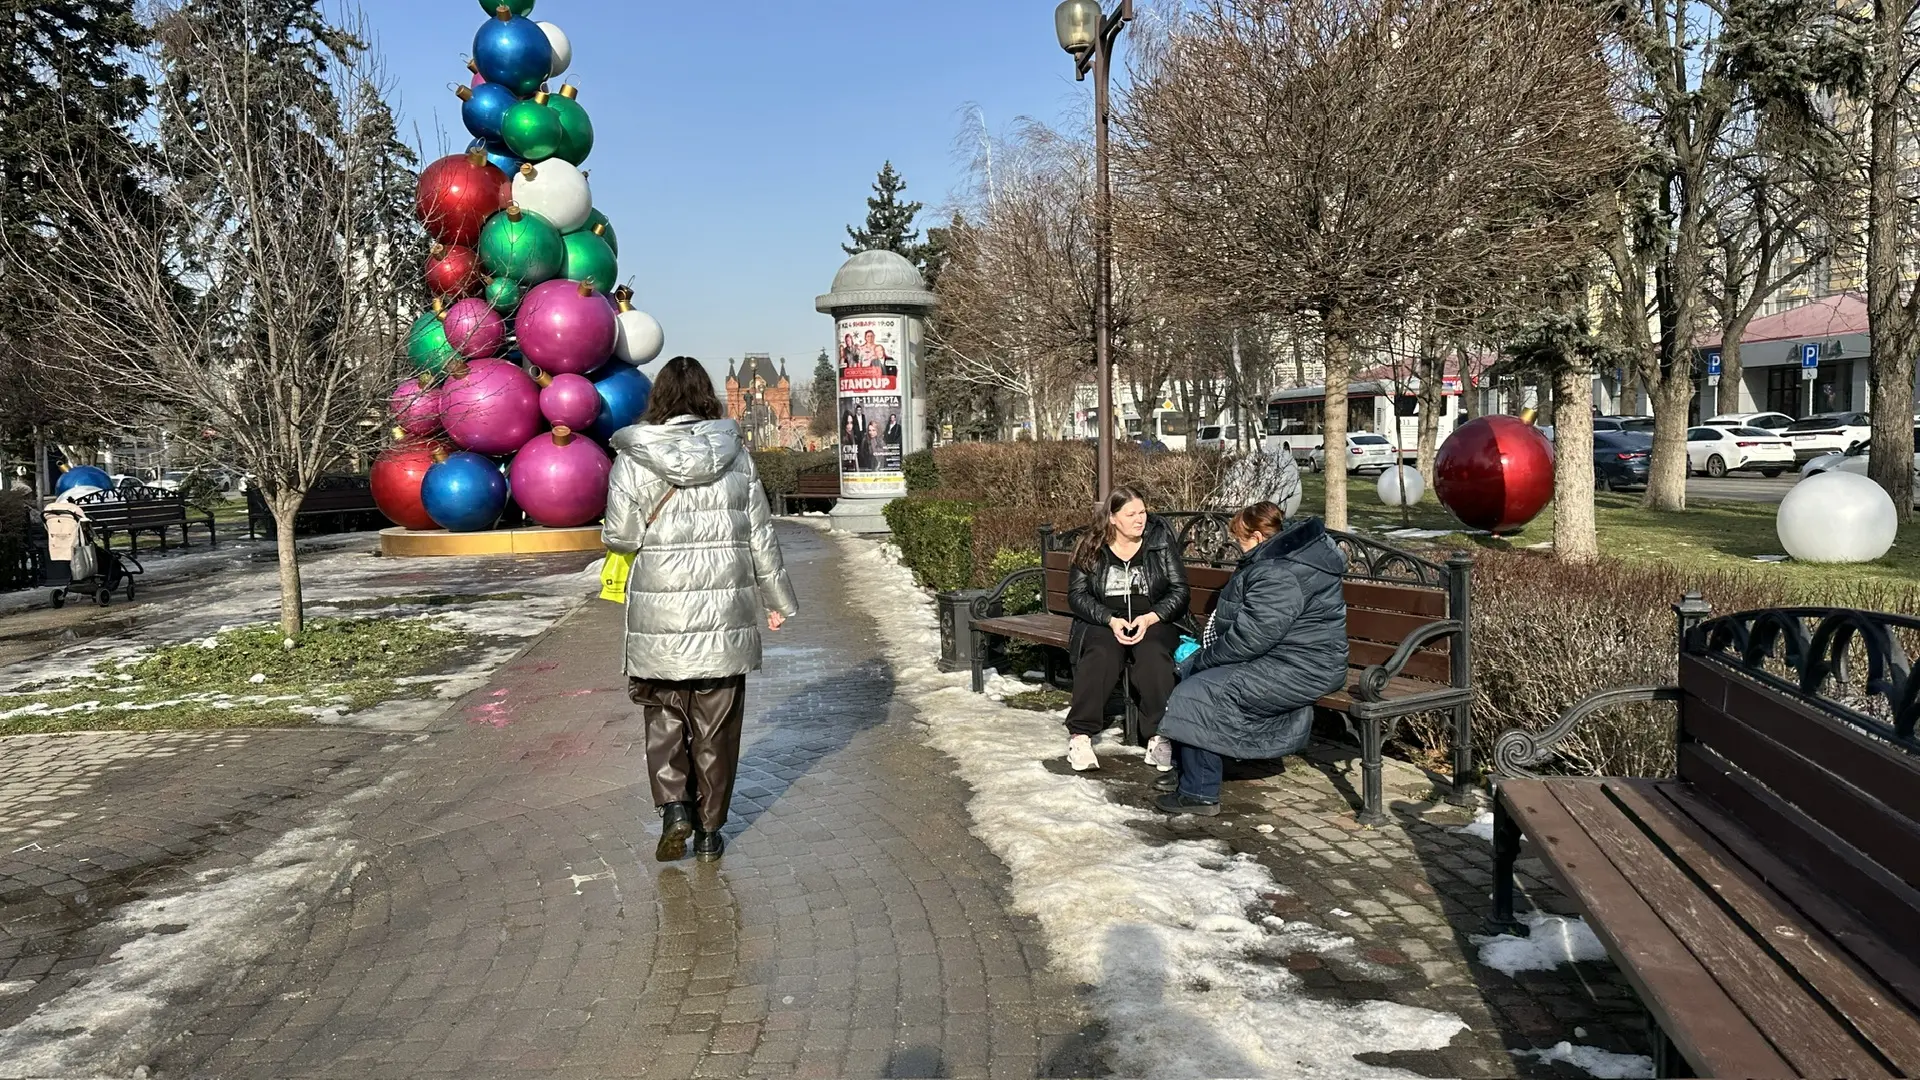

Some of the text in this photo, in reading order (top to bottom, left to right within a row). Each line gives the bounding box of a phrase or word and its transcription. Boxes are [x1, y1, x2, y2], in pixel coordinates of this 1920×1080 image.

[1806, 347, 1815, 365] P
[840, 377, 890, 390] STANDUP
[852, 396, 899, 404] 10-11 МАРТА
